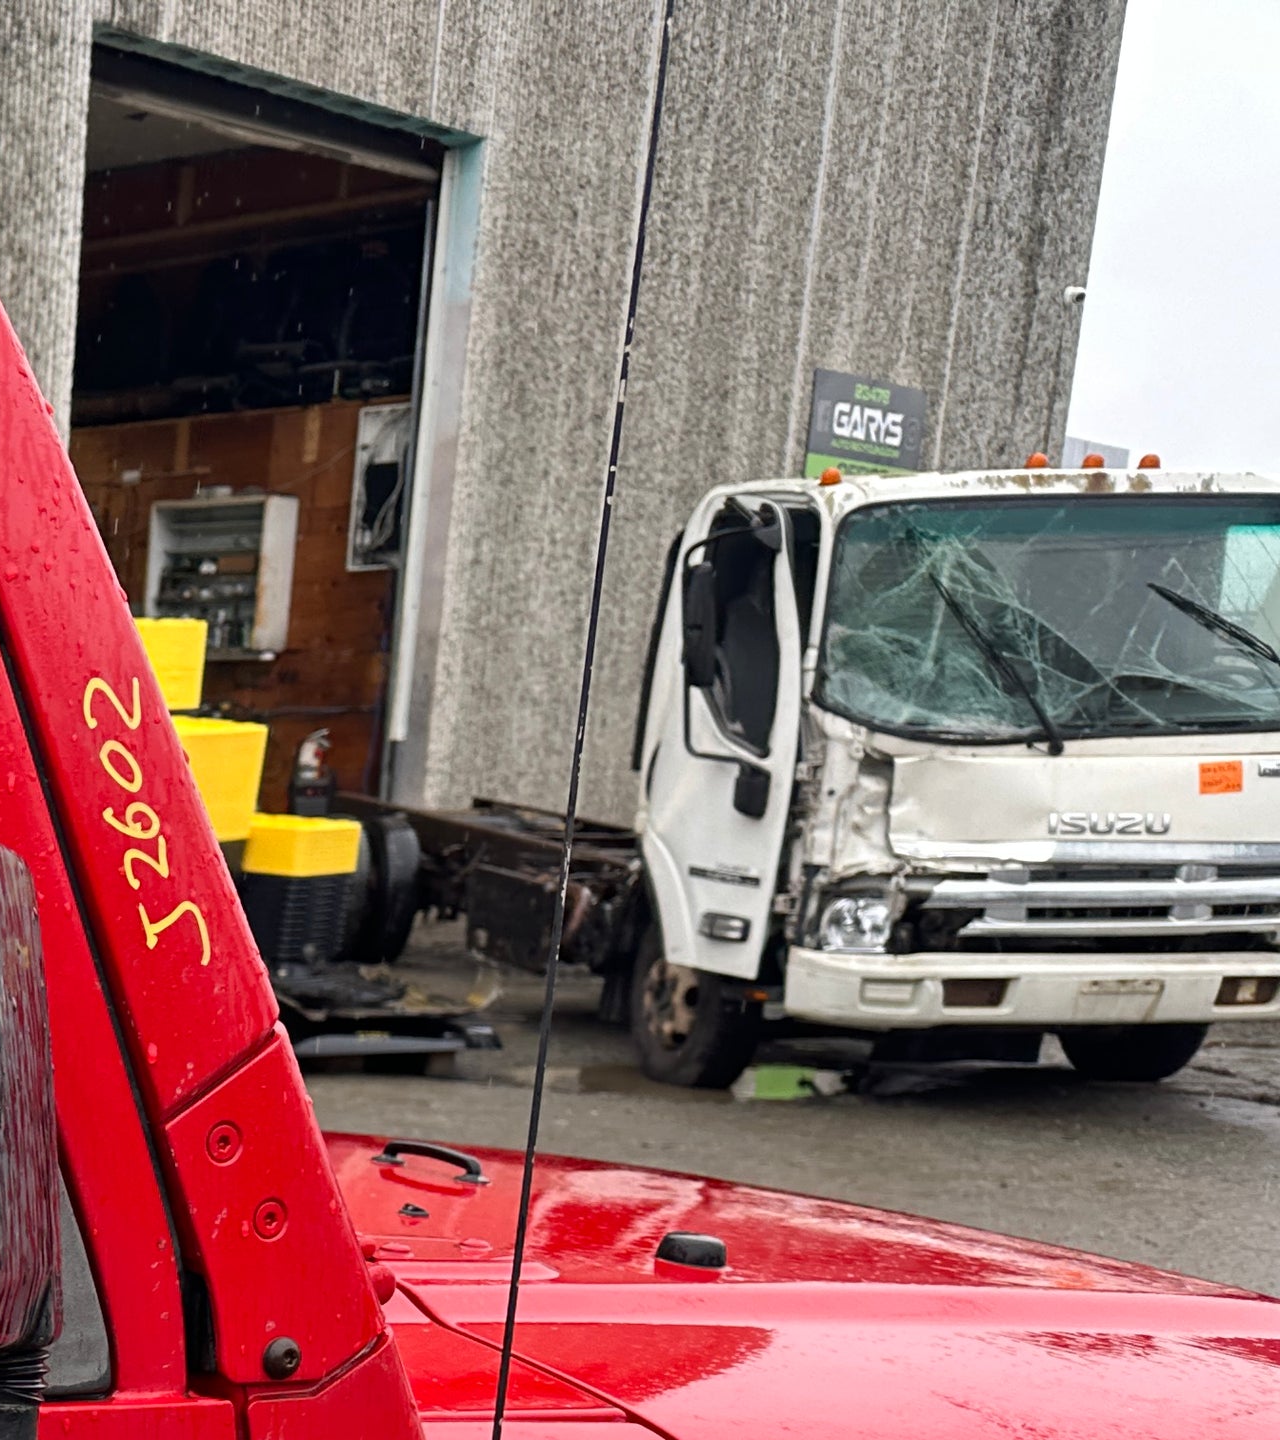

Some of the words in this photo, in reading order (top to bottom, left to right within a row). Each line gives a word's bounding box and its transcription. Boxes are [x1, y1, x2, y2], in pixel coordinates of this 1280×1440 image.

[833, 402, 904, 447] GARYS
[83, 676, 211, 966] J2602
[1048, 812, 1171, 834] ISUZU
